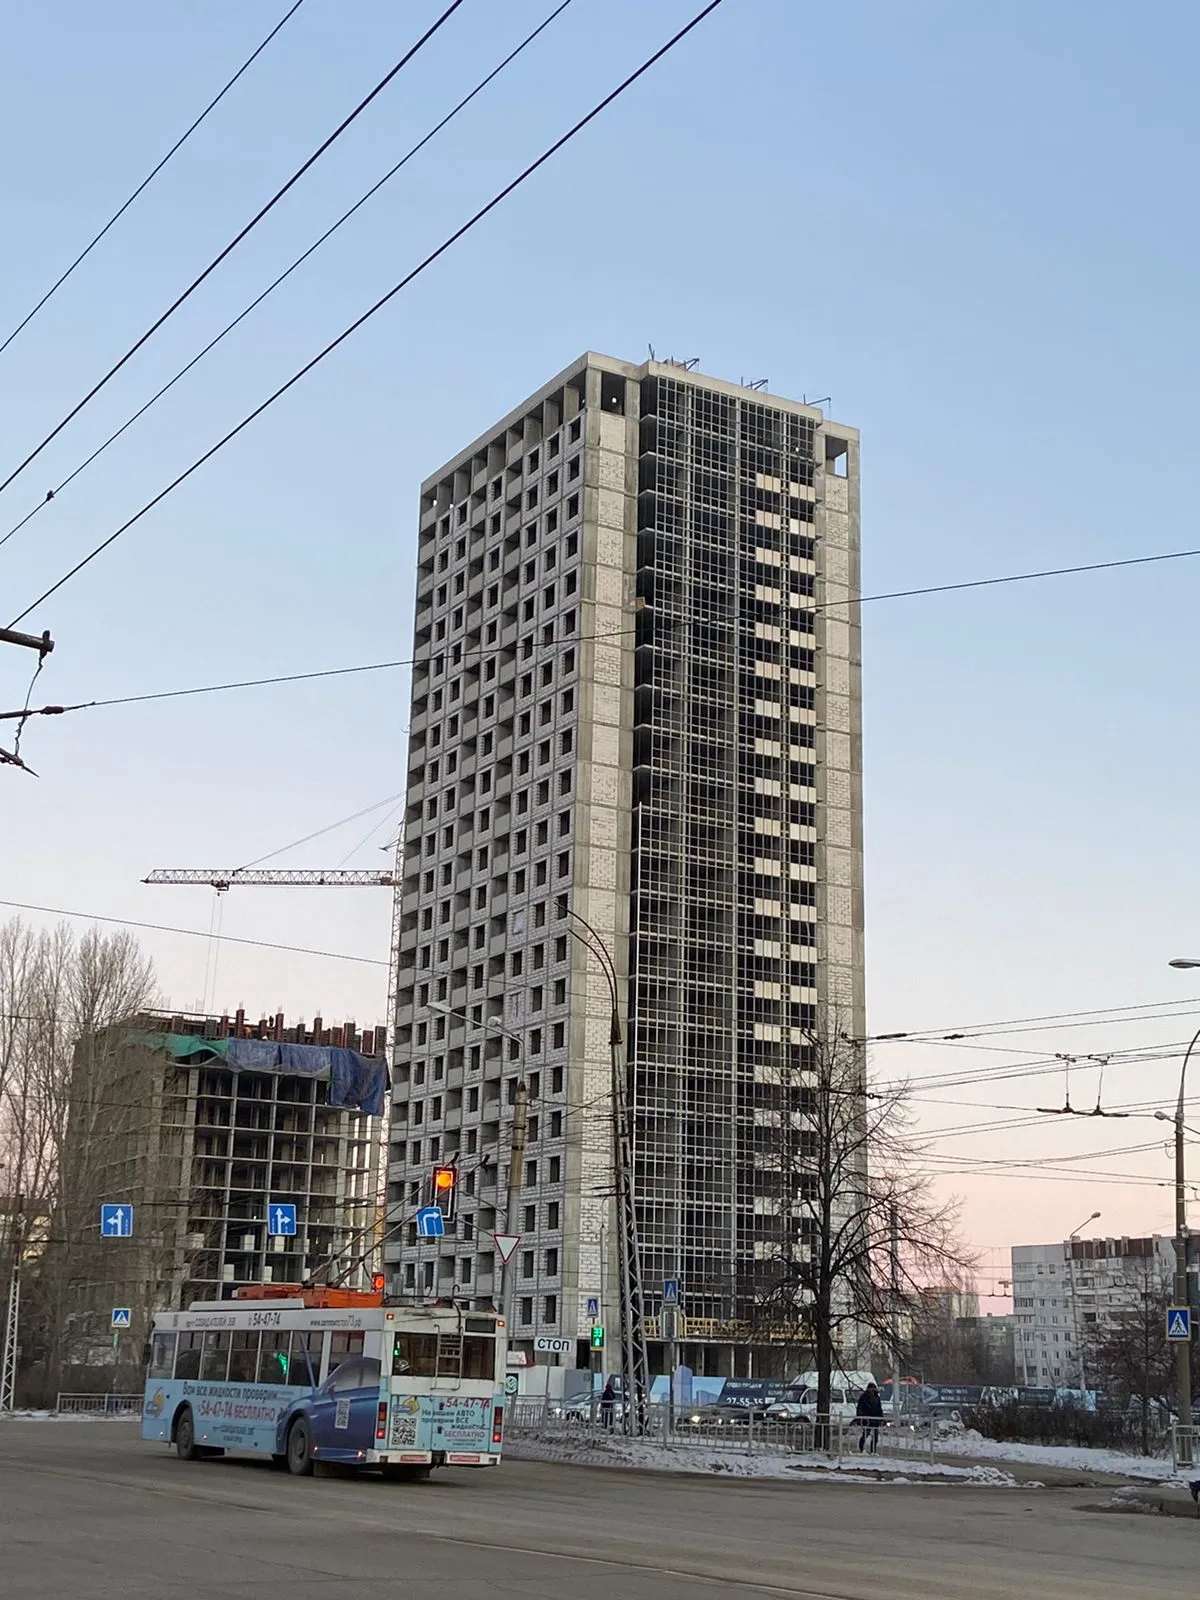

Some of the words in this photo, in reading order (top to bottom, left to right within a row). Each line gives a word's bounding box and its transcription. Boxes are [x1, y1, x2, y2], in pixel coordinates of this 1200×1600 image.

[252, 1312, 281, 1326] 54-47-74
[537, 1338, 570, 1351] СТОП
[196, 1386, 208, 1396] все
[208, 1385, 241, 1399] жидкости
[243, 1387, 278, 1404] проверим
[445, 1398, 491, 1408] 54-47-74
[201, 1400, 233, 1418] 54-47-74
[234, 1404, 276, 1421] БЕСПЛАТНО
[444, 1430, 486, 1438] БЕСПЛАТНО
